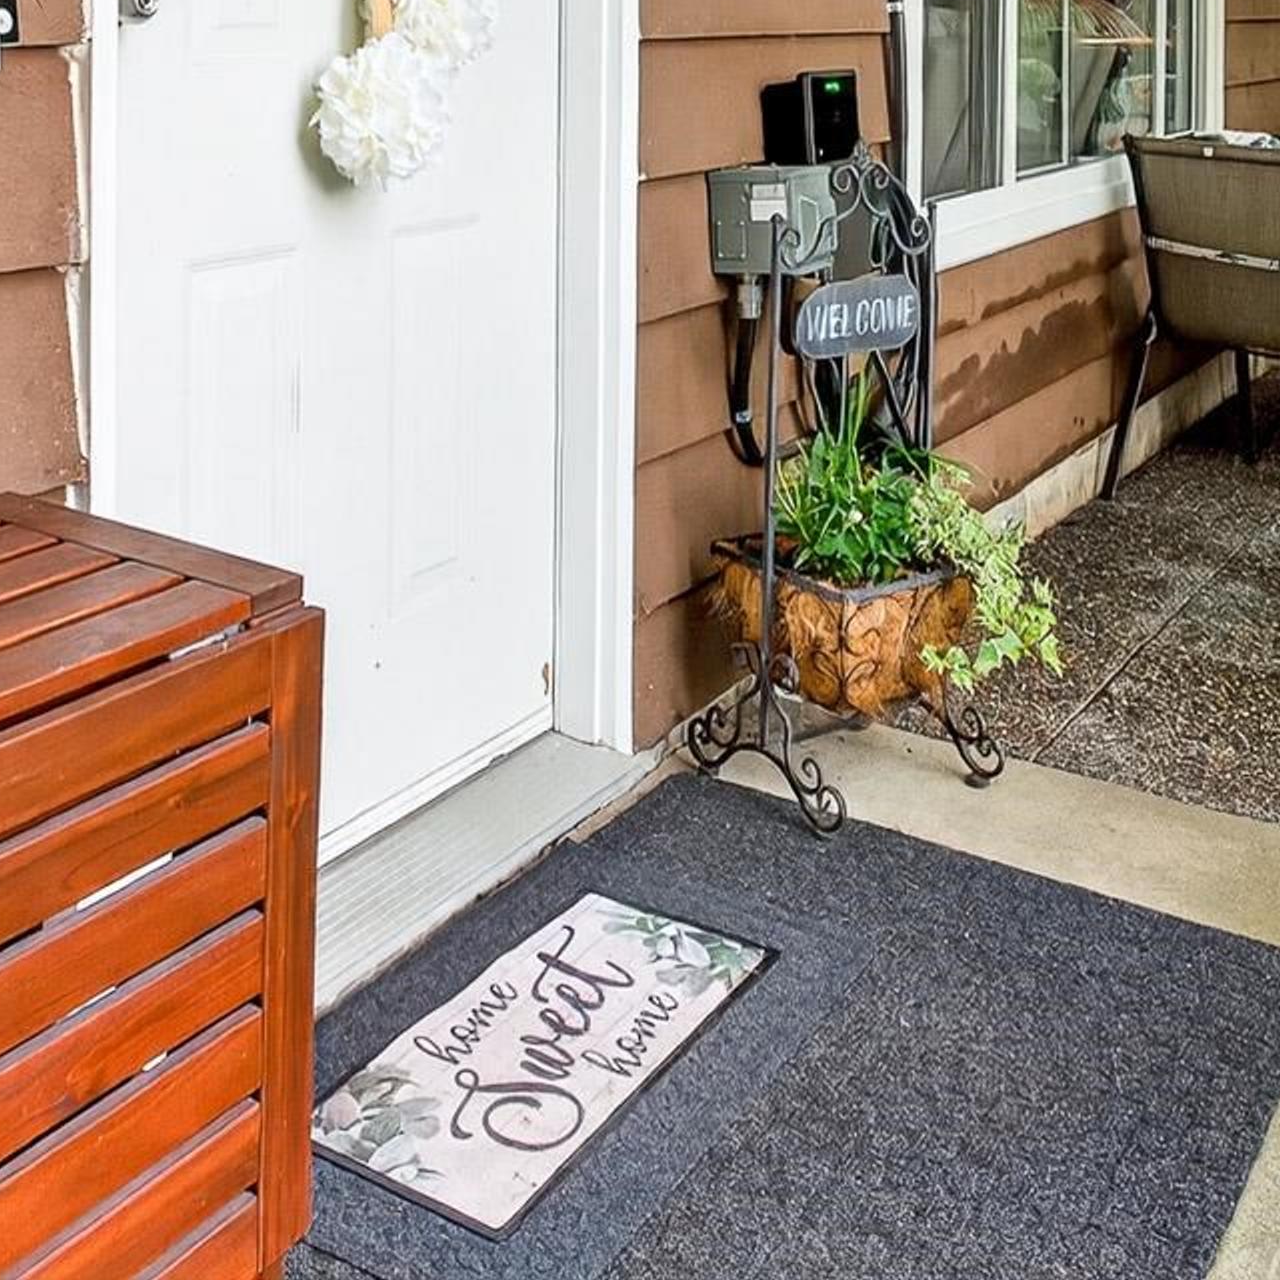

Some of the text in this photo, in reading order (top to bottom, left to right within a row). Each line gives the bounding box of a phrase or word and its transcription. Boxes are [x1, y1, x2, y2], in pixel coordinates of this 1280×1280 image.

[804, 293, 916, 343] WELCOME
[413, 979, 519, 1065] home
[449, 924, 636, 1152] Sweet
[580, 990, 680, 1079] home
